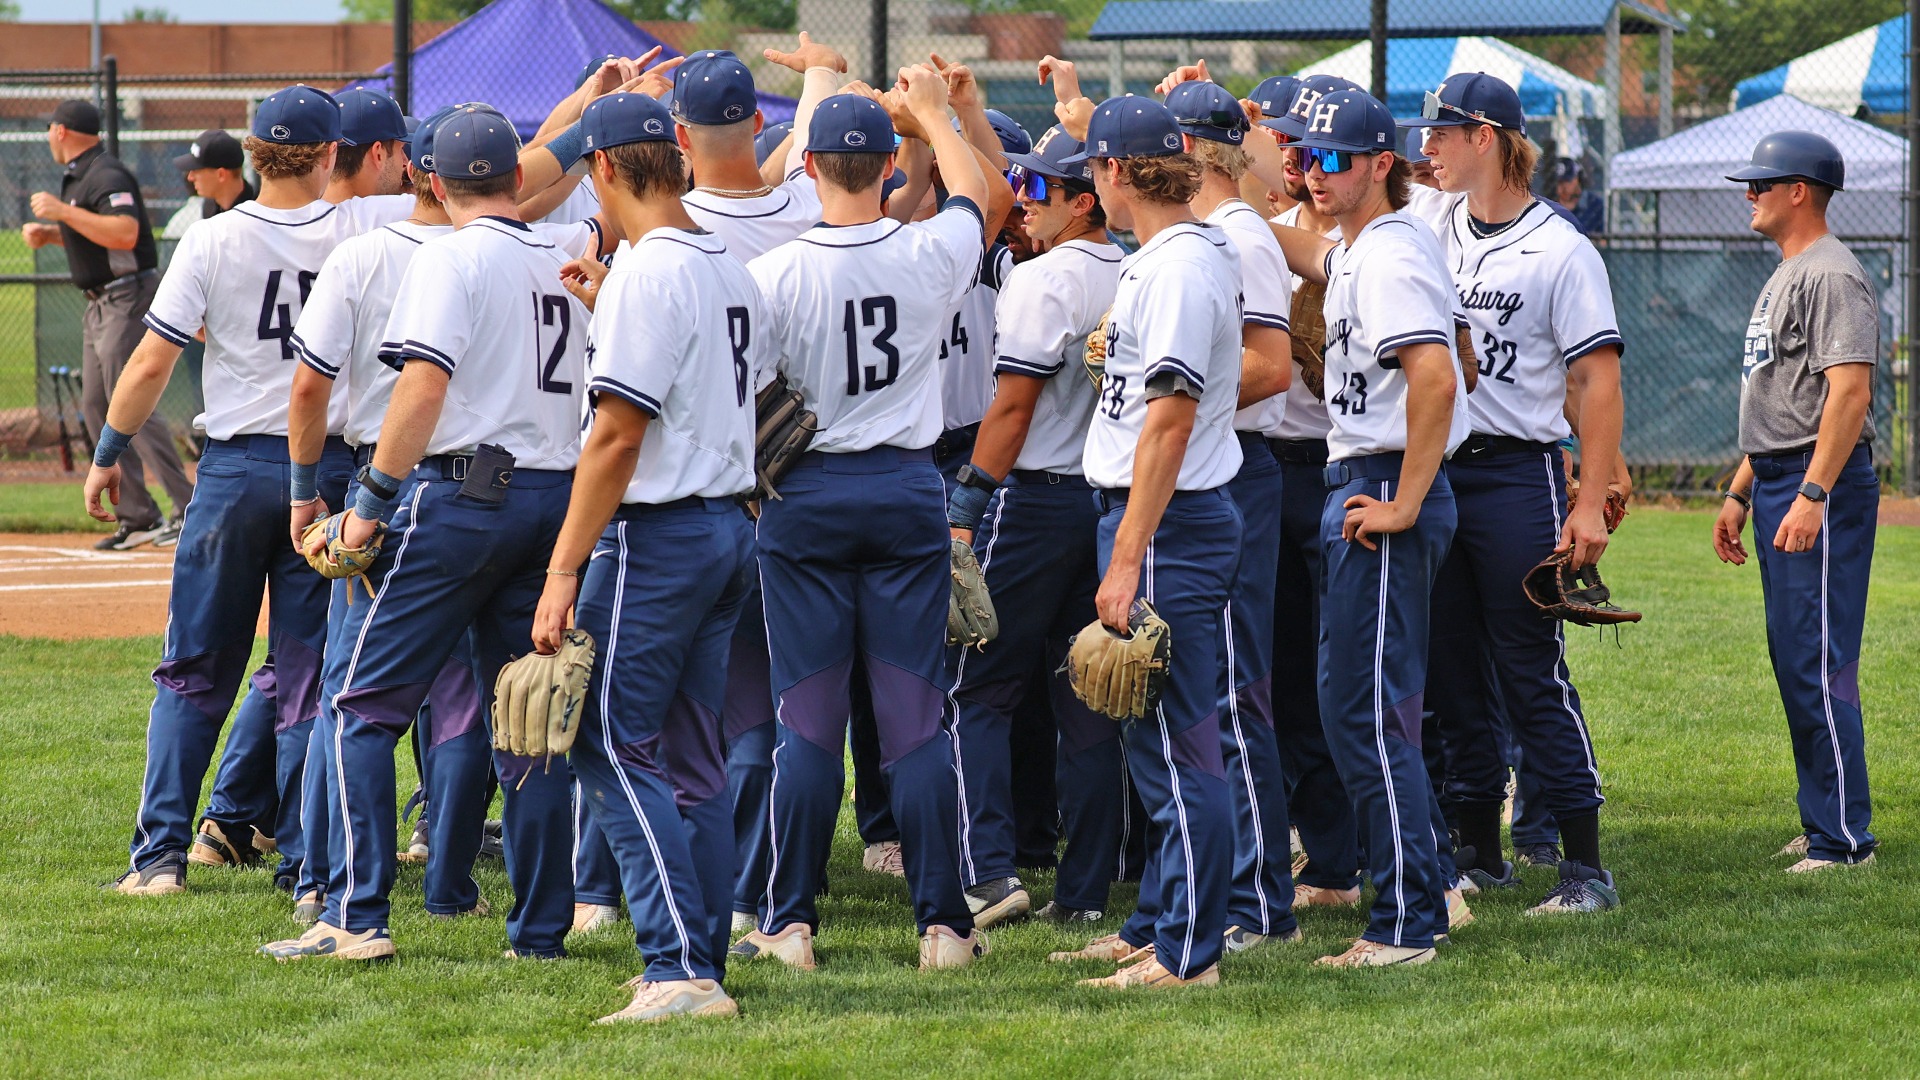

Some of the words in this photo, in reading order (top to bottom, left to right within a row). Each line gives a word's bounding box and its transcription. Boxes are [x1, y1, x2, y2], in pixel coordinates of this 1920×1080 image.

[1290, 87, 1323, 119] H
[1308, 103, 1340, 134] H
[257, 270, 320, 360] 4
[1455, 282, 1524, 327] sburg
[531, 290, 573, 395] 12
[843, 295, 900, 396] 13
[1476, 331, 1518, 385] 32
[1331, 372, 1368, 416] 43
